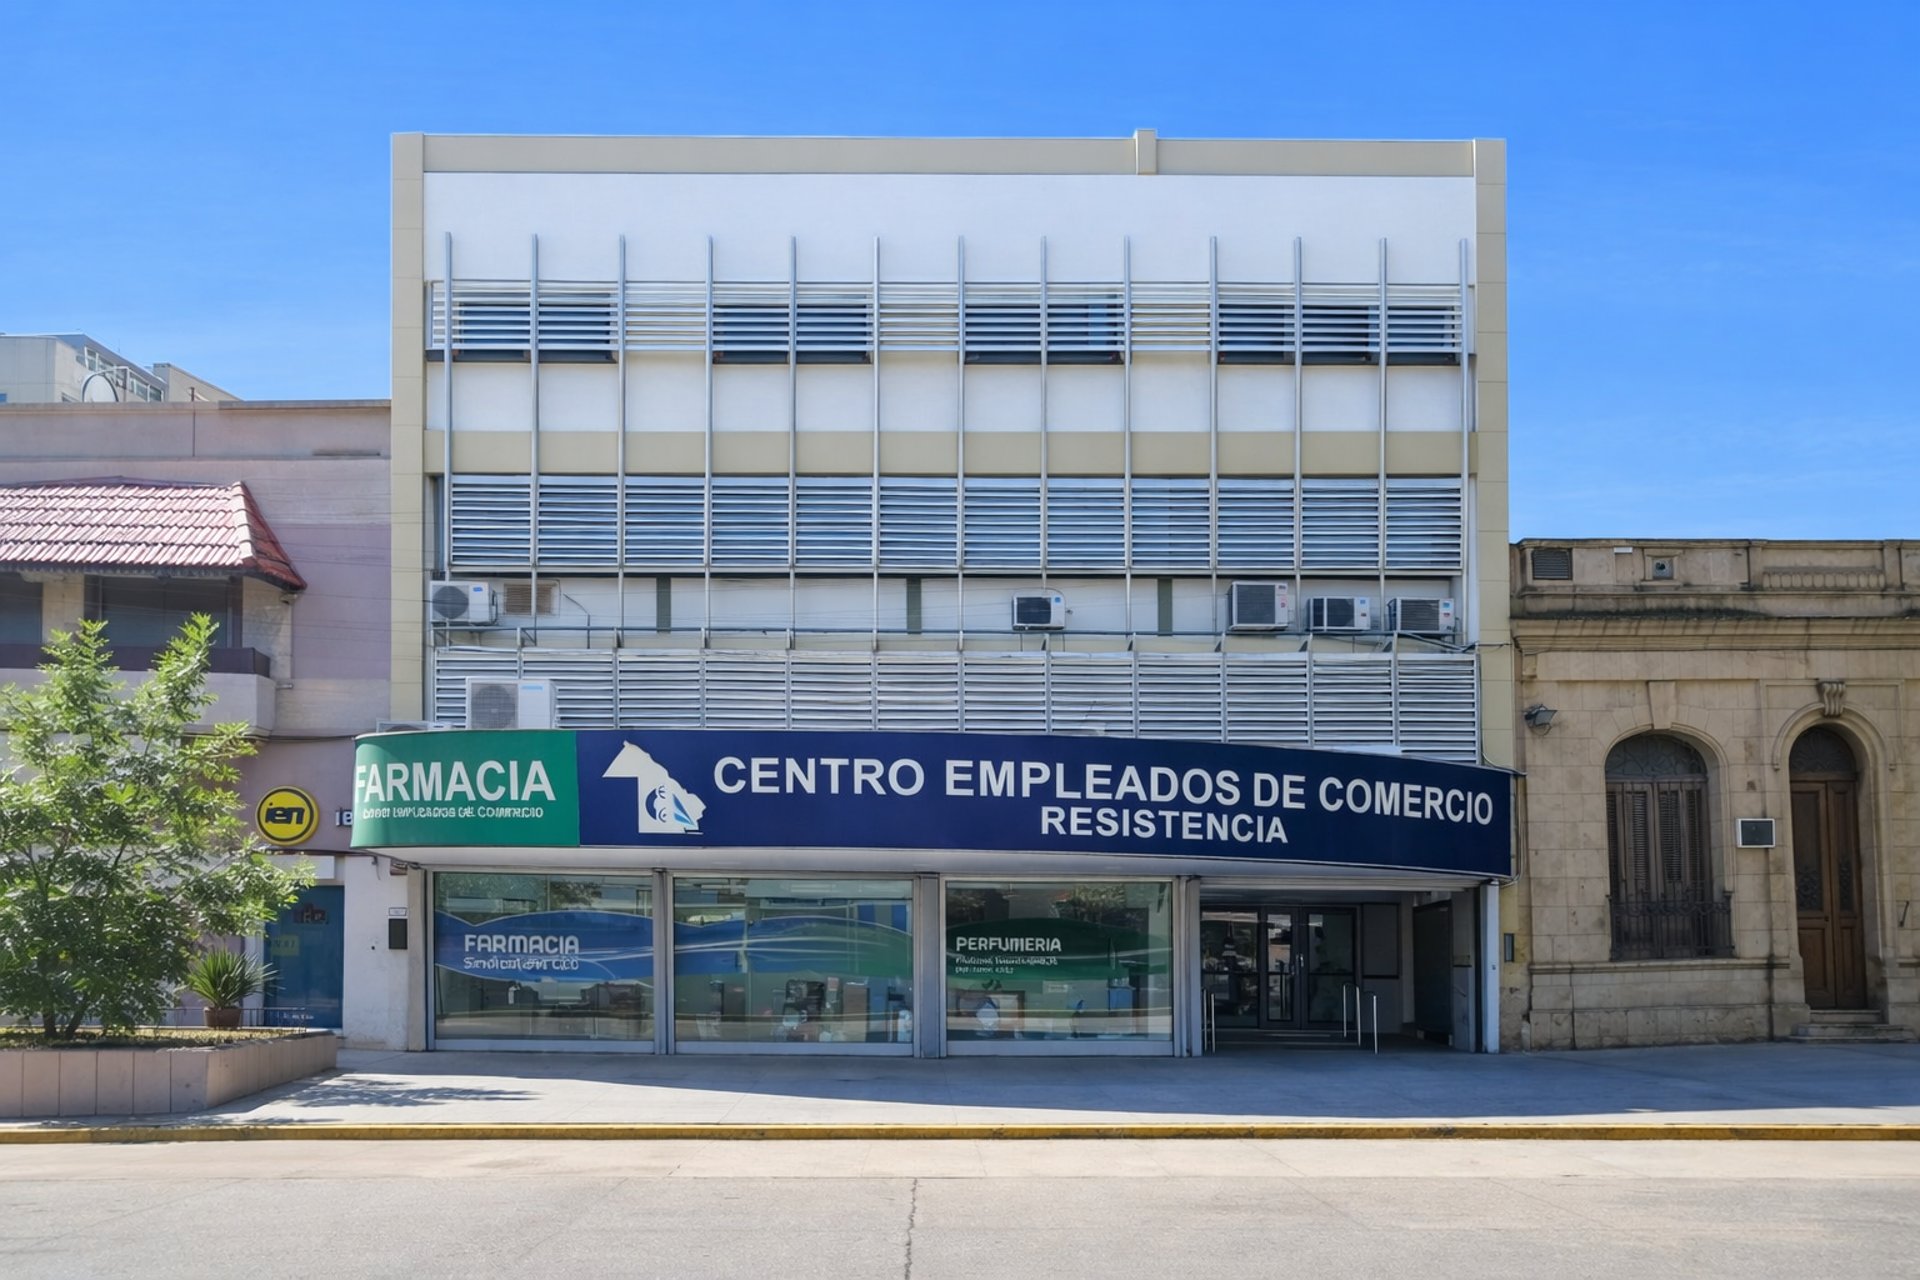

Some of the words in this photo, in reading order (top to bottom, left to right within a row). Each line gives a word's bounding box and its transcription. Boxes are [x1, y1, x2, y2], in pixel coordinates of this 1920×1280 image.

[355, 760, 557, 803] FARMACIA
[713, 756, 925, 796] CENTRO
[945, 759, 1241, 806] EMPLEADOS
[1253, 772, 1306, 809] DE
[1318, 777, 1494, 825] COMERCIO
[1040, 806, 1289, 844] RESISTENCIA
[464, 934, 579, 954] FARMACIA
[956, 937, 1062, 952] PERFUMERIA
